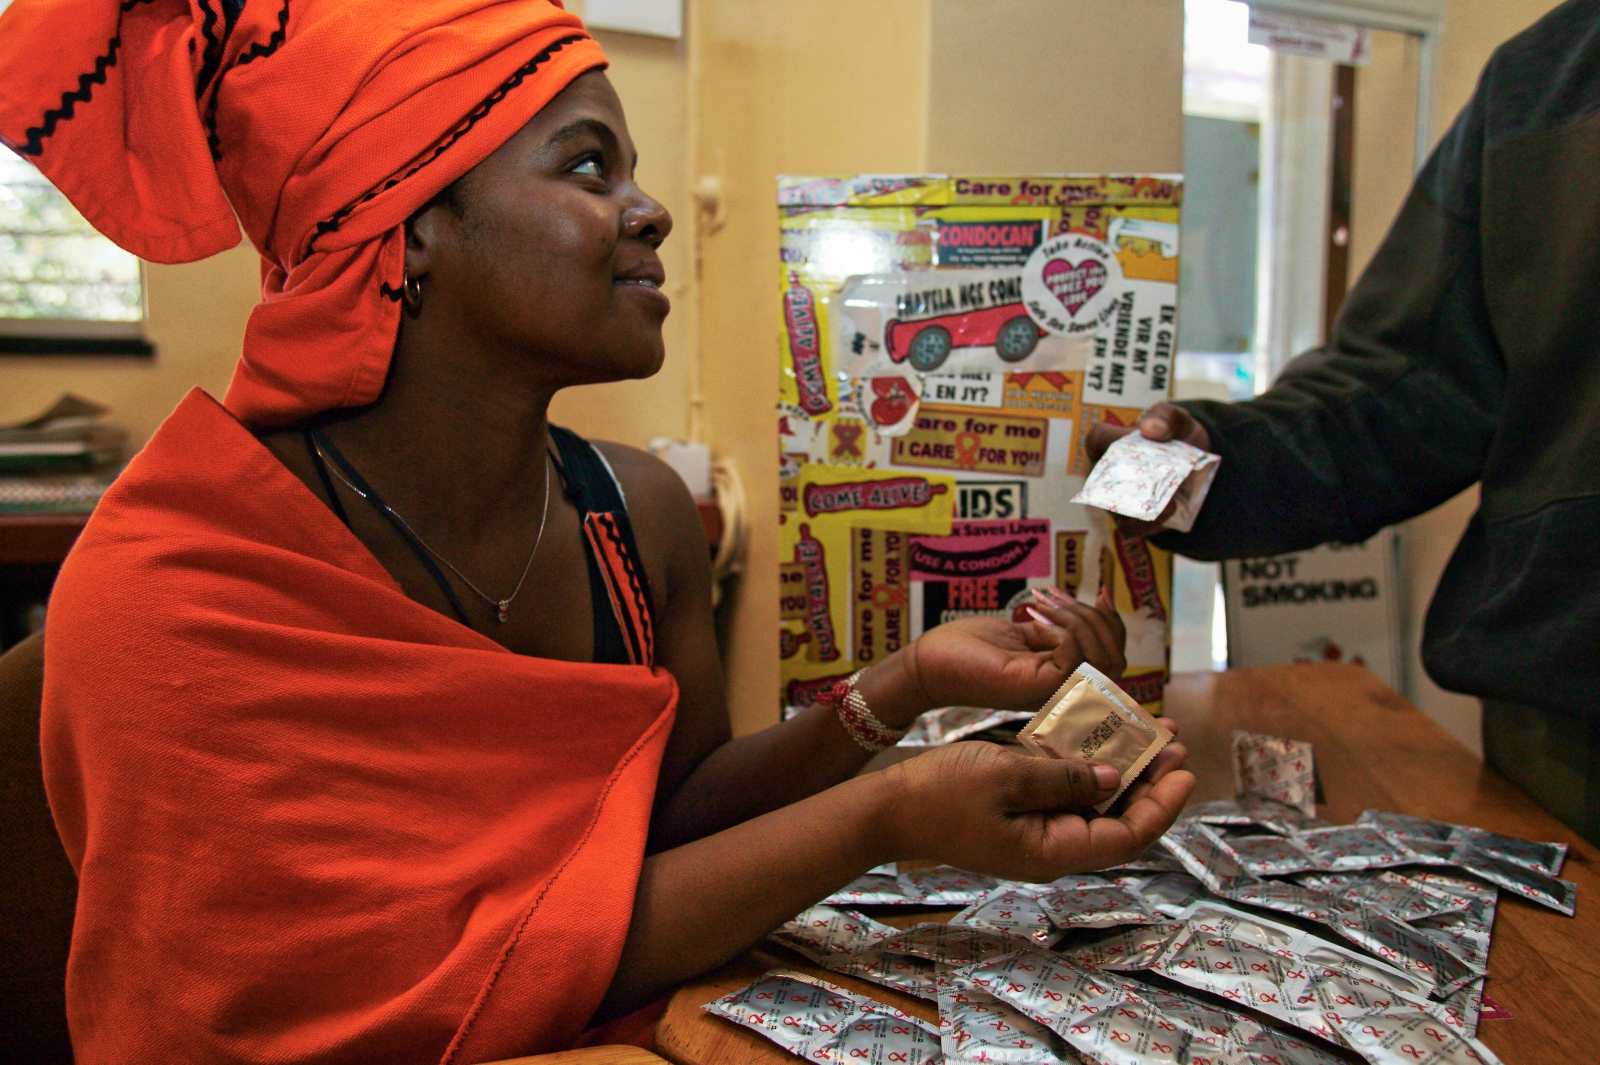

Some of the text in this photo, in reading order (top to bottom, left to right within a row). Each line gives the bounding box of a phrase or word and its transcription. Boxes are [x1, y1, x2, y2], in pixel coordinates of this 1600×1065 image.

[955, 178, 1011, 196] Care
[1020, 179, 1052, 198] for
[1108, 291, 1135, 396] VRIENDE MET
[1132, 316, 1153, 375] VIR MY
[1155, 329, 1172, 359] GEE
[801, 358, 827, 411] COME
[1150, 364, 1168, 391] OM
[936, 385, 957, 400] EN
[961, 386, 989, 403] JY?
[912, 416, 1042, 438] are for me
[909, 441, 955, 460] CARE
[978, 447, 1007, 464] FOR
[810, 489, 863, 510] COME
[953, 488, 1014, 519] IDS
[963, 523, 1006, 537] Saves
[1008, 522, 1048, 535] Lives
[885, 557, 900, 585] FOR
[914, 544, 1024, 571] USE A CONDOM
[1065, 537, 1077, 575] me
[1240, 558, 1298, 580] NOT
[859, 570, 874, 601] for
[949, 579, 1000, 610] FREE
[1242, 578, 1378, 608] SMOKING
[811, 607, 834, 658] COME
[859, 609, 874, 662] Care
[885, 608, 900, 652] CARE
